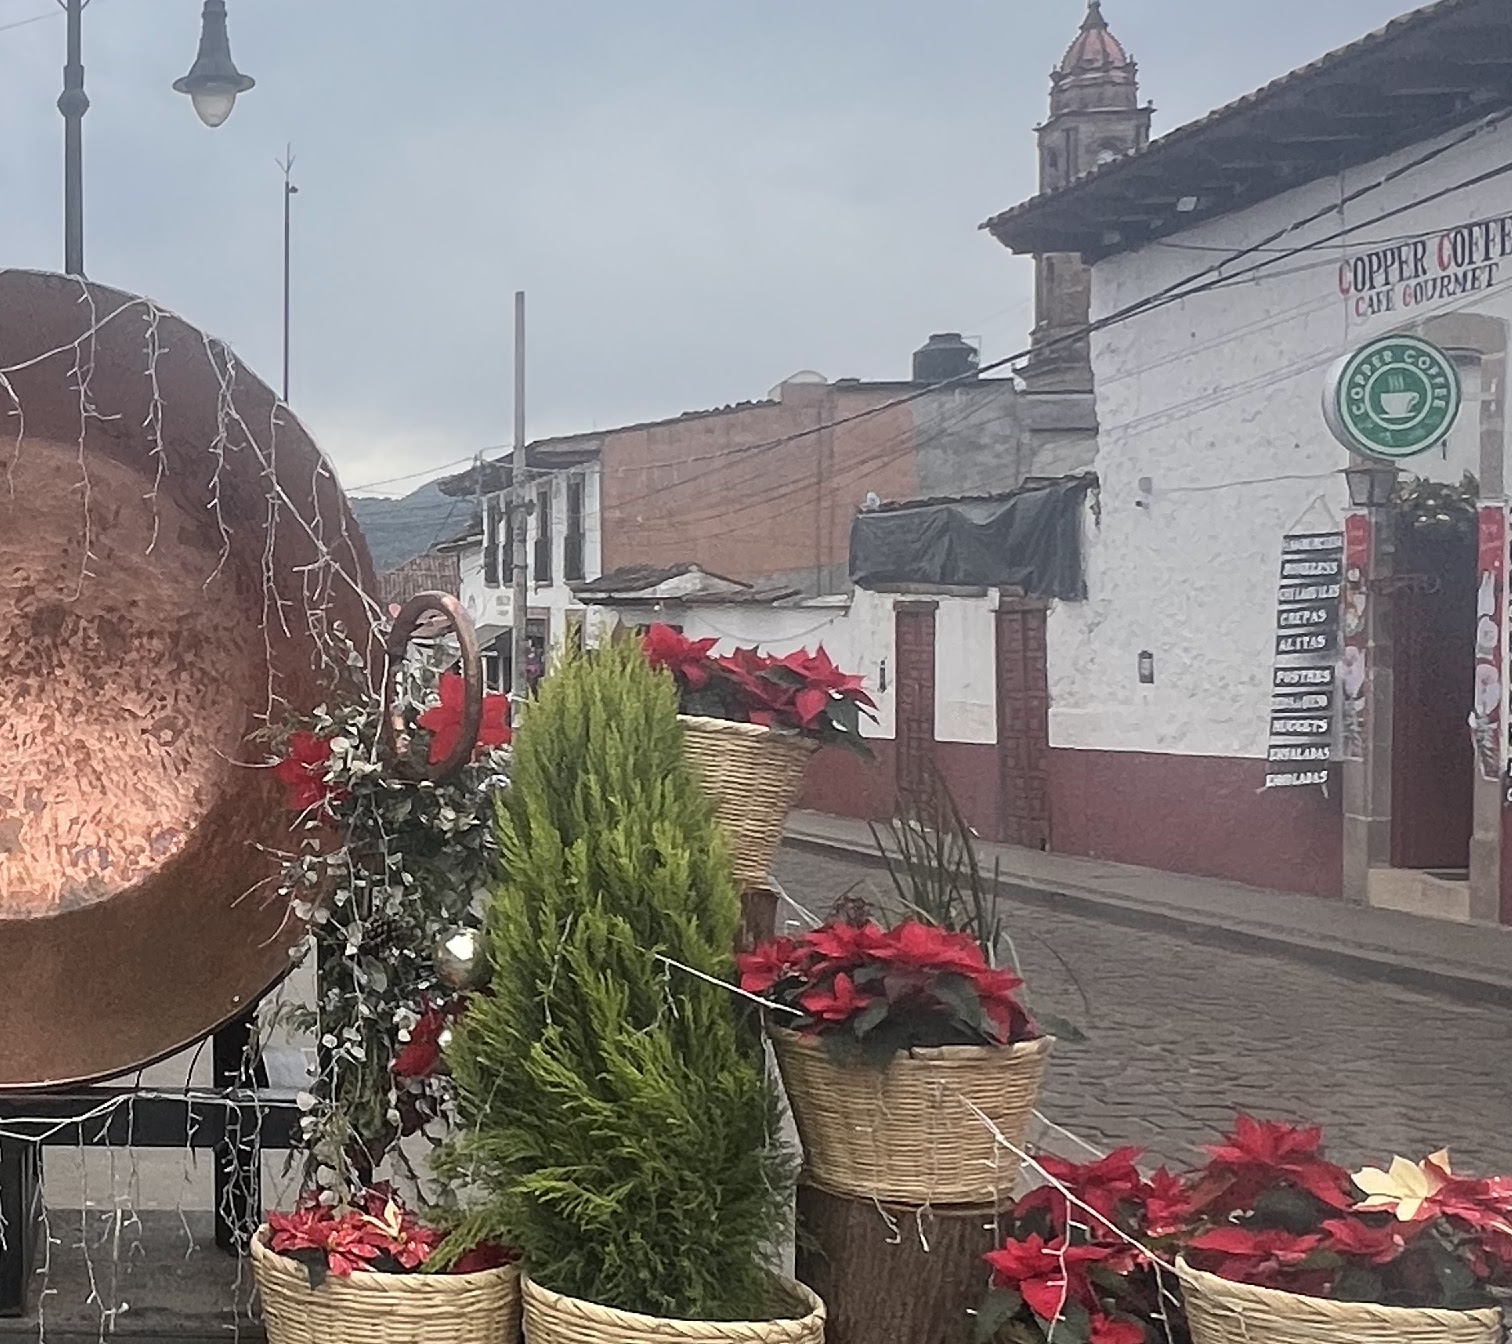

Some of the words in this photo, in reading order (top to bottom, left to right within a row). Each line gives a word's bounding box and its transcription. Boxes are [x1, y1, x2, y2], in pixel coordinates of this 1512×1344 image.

[1339, 240, 1428, 296] COPPER
[1403, 262, 1500, 307] GOURMET
[1350, 350, 1394, 415] COPPER
[1403, 349, 1448, 409] COFFEE
[1280, 609, 1328, 626] CREPAS
[1278, 635, 1326, 652] ALITAS
[1275, 669, 1331, 684] POSTRES
[1272, 718, 1328, 733] NUGGETS
[1268, 746, 1330, 761] ENSALADAS
